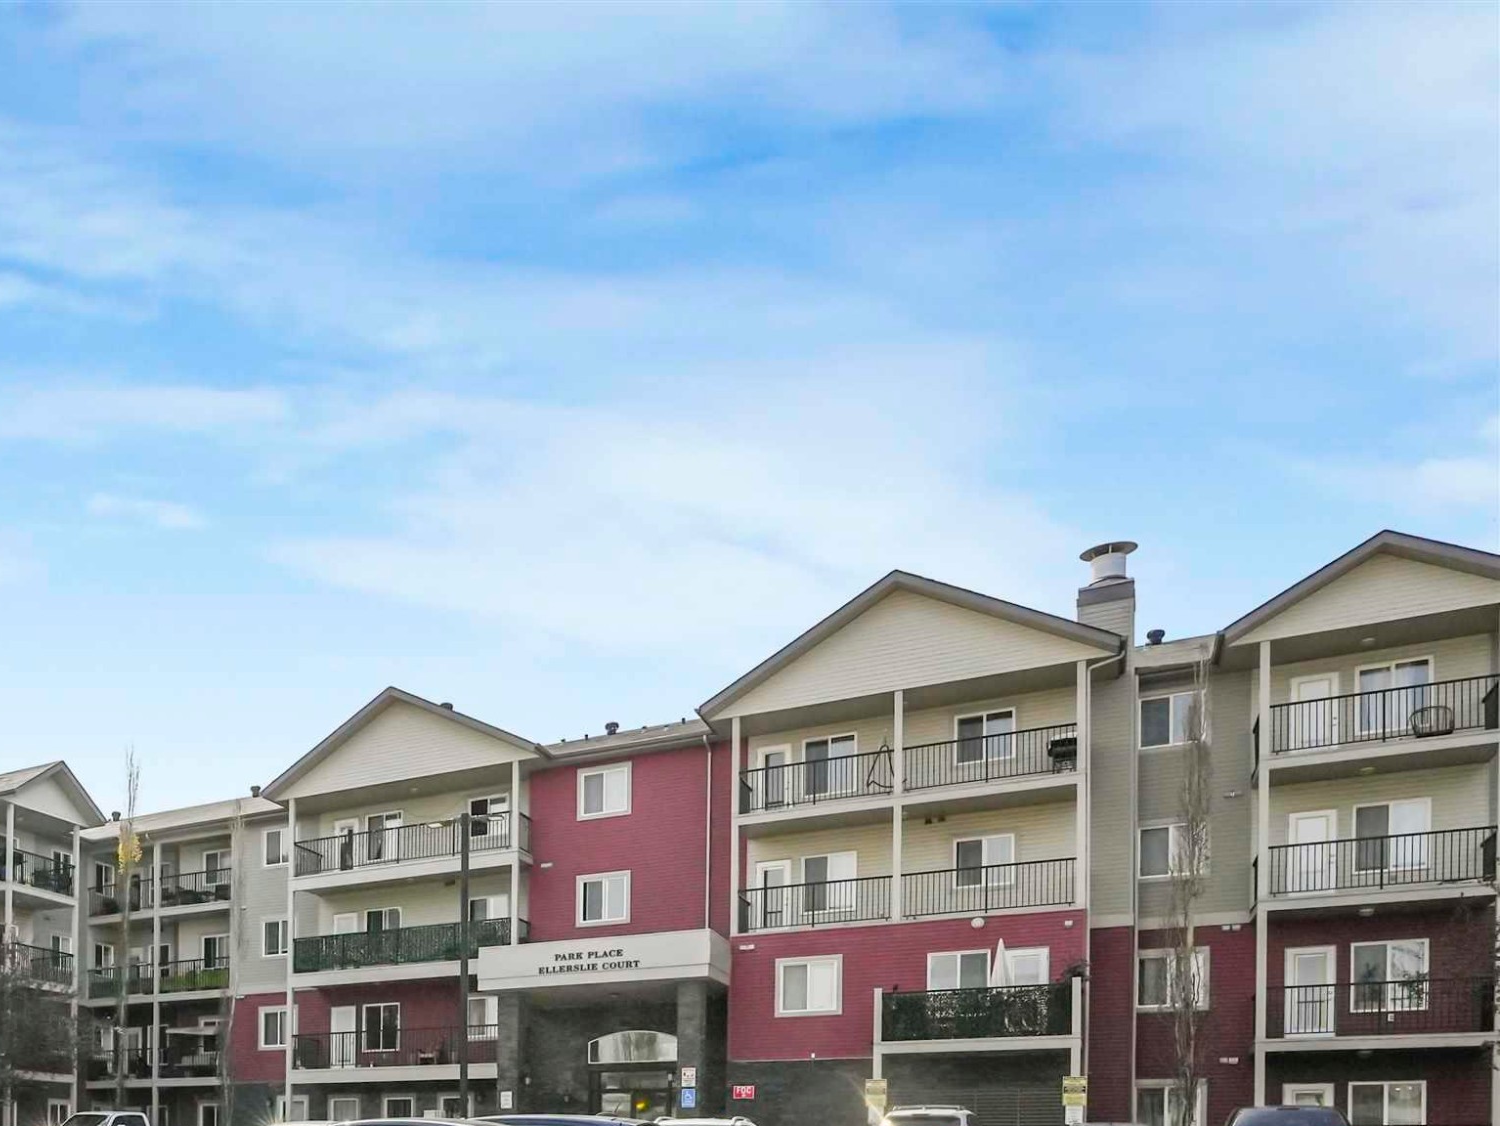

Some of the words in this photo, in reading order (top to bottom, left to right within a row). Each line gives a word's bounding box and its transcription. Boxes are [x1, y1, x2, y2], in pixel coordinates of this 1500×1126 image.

[554, 952, 583, 962] PARK
[587, 949, 624, 959] PLACE
[538, 963, 598, 975] ELLERSLIE
[602, 960, 640, 970] COURT
